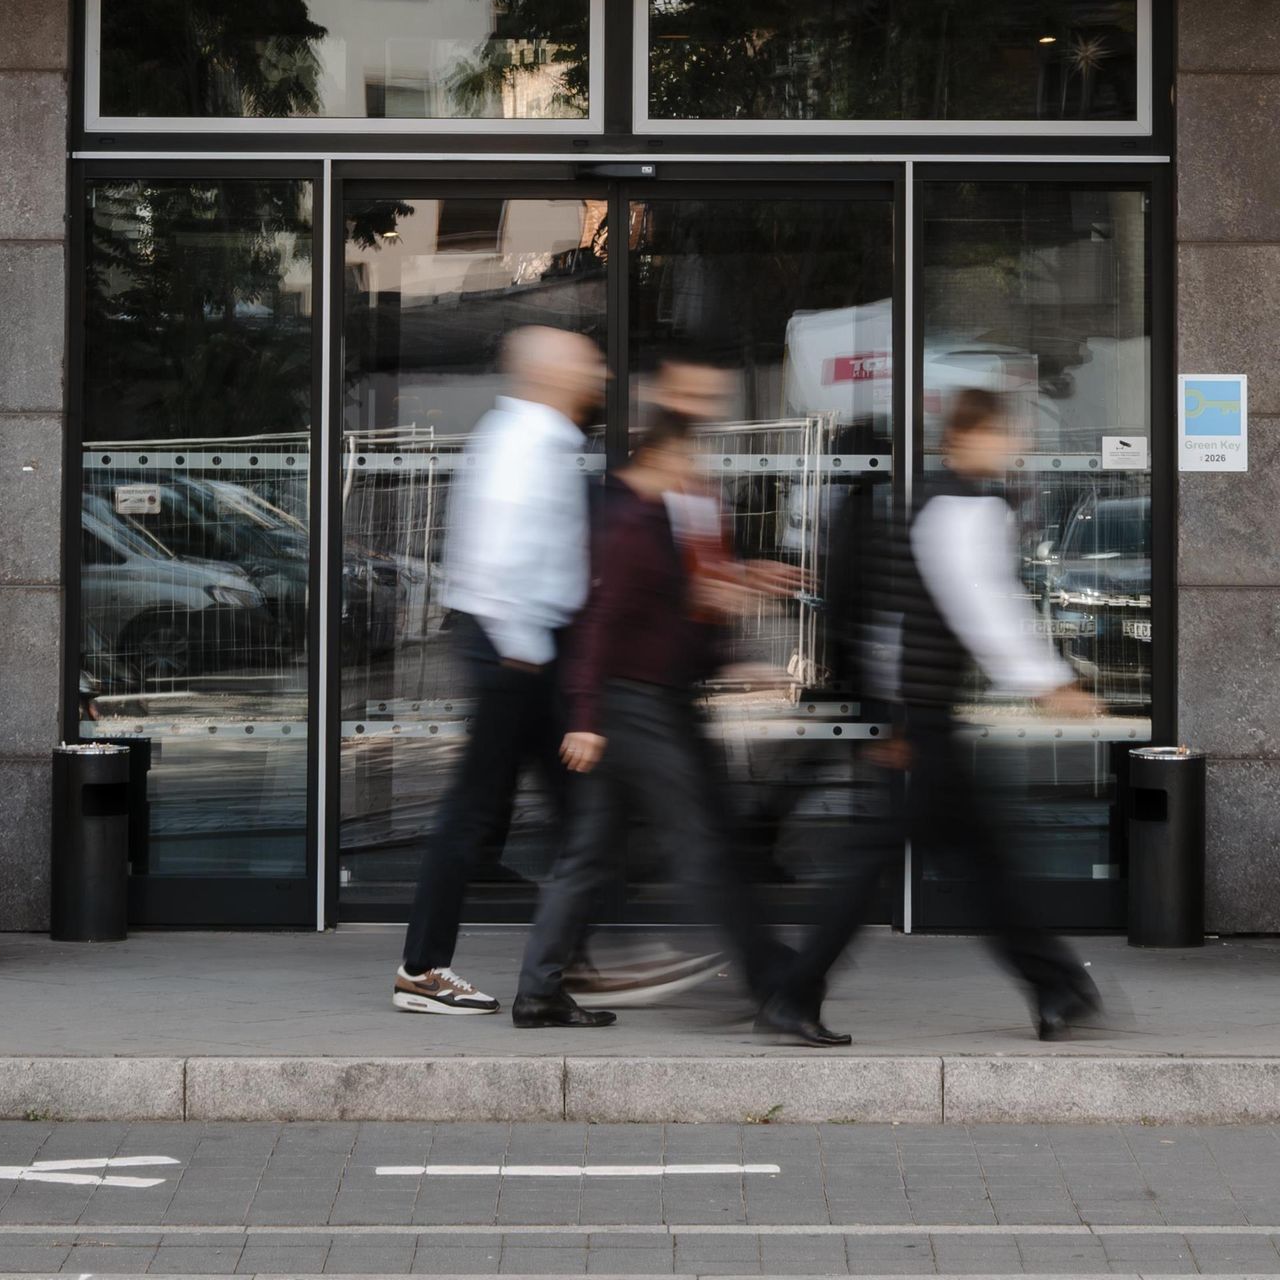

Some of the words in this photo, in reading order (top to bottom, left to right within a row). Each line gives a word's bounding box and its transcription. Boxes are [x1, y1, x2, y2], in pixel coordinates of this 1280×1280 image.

[1184, 440, 1218, 450] Green
[1221, 440, 1241, 452] Key
[1204, 454, 1226, 462] 2026
